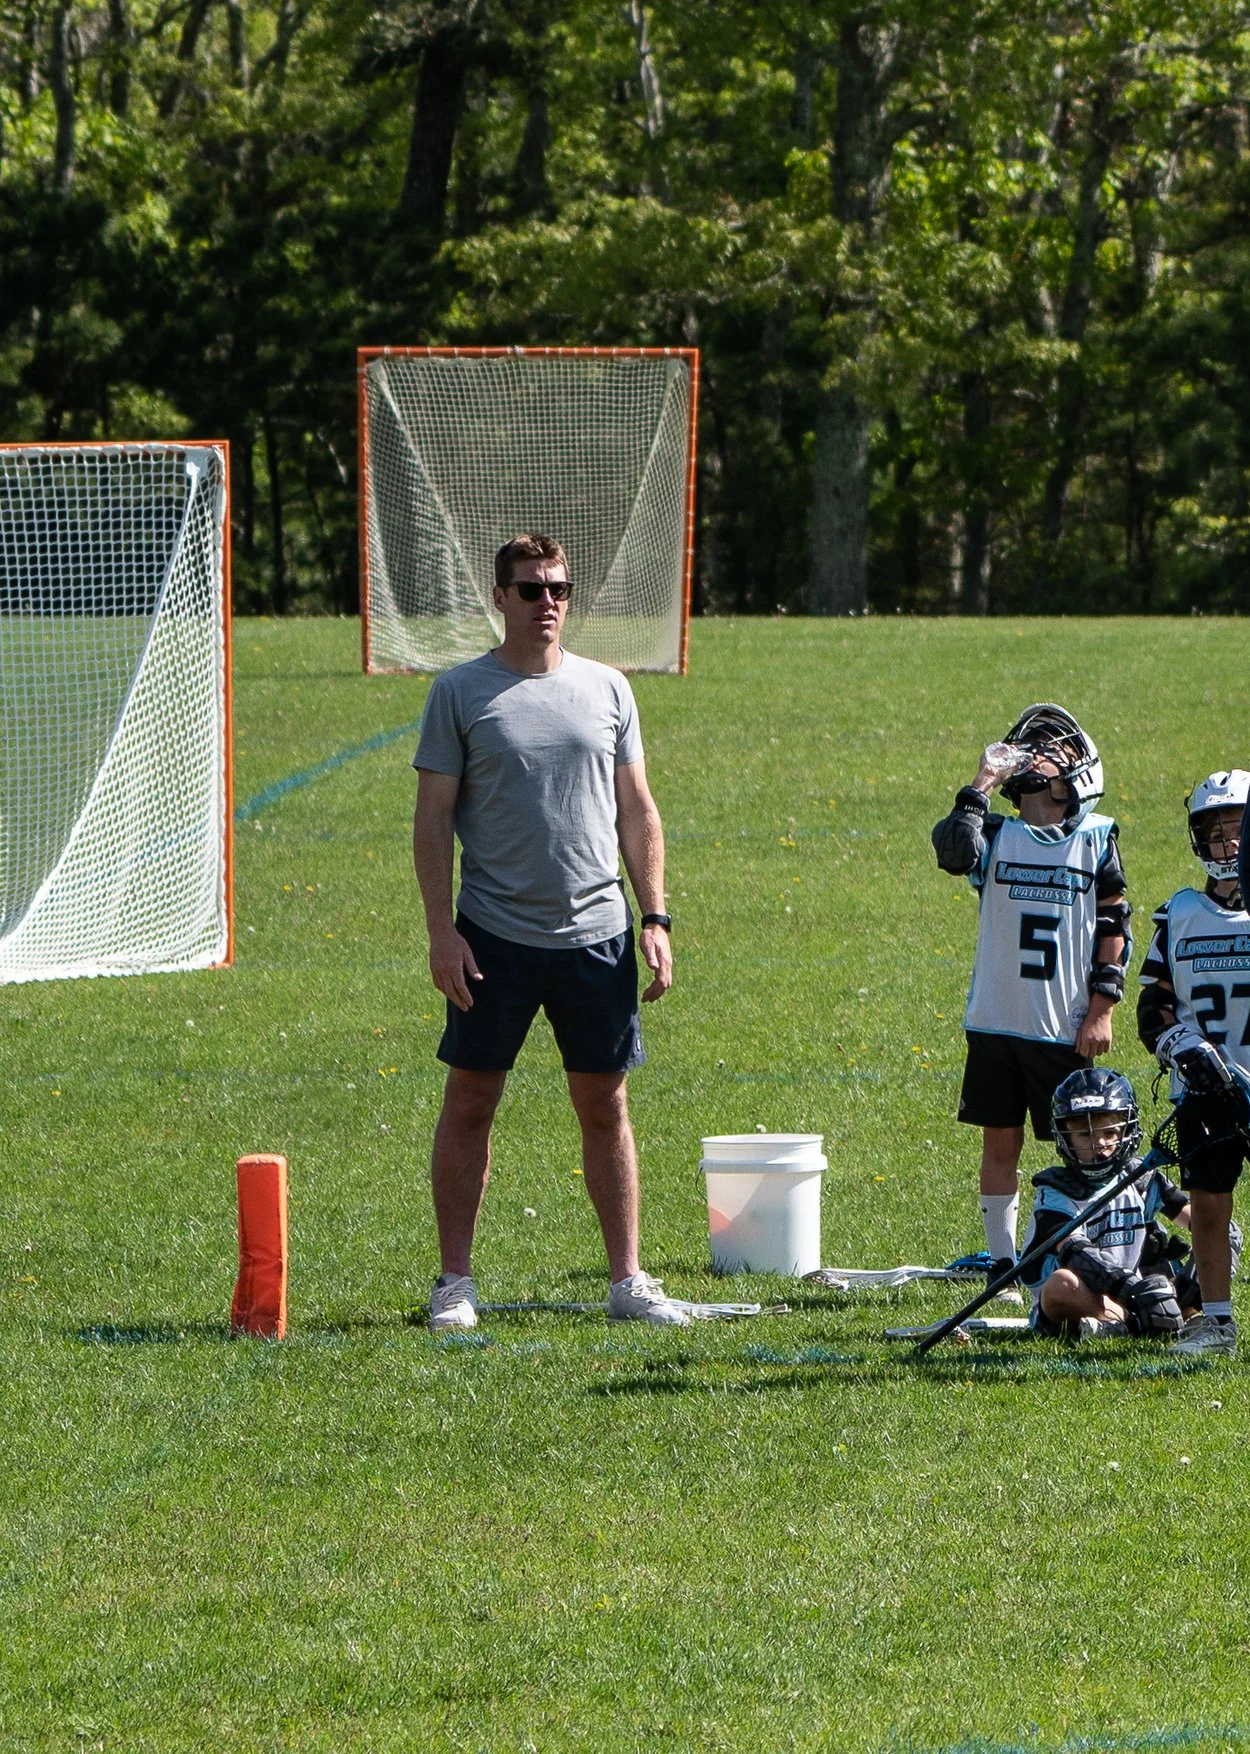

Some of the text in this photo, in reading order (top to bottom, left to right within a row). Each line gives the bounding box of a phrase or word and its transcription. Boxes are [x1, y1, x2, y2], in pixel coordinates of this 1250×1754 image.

[996, 862, 1055, 884] Lower
[1013, 886, 1072, 902] LACROSSE
[1019, 911, 1062, 981] 5
[1176, 938, 1234, 958] Lower
[1161, 1027, 1190, 1057] STX
